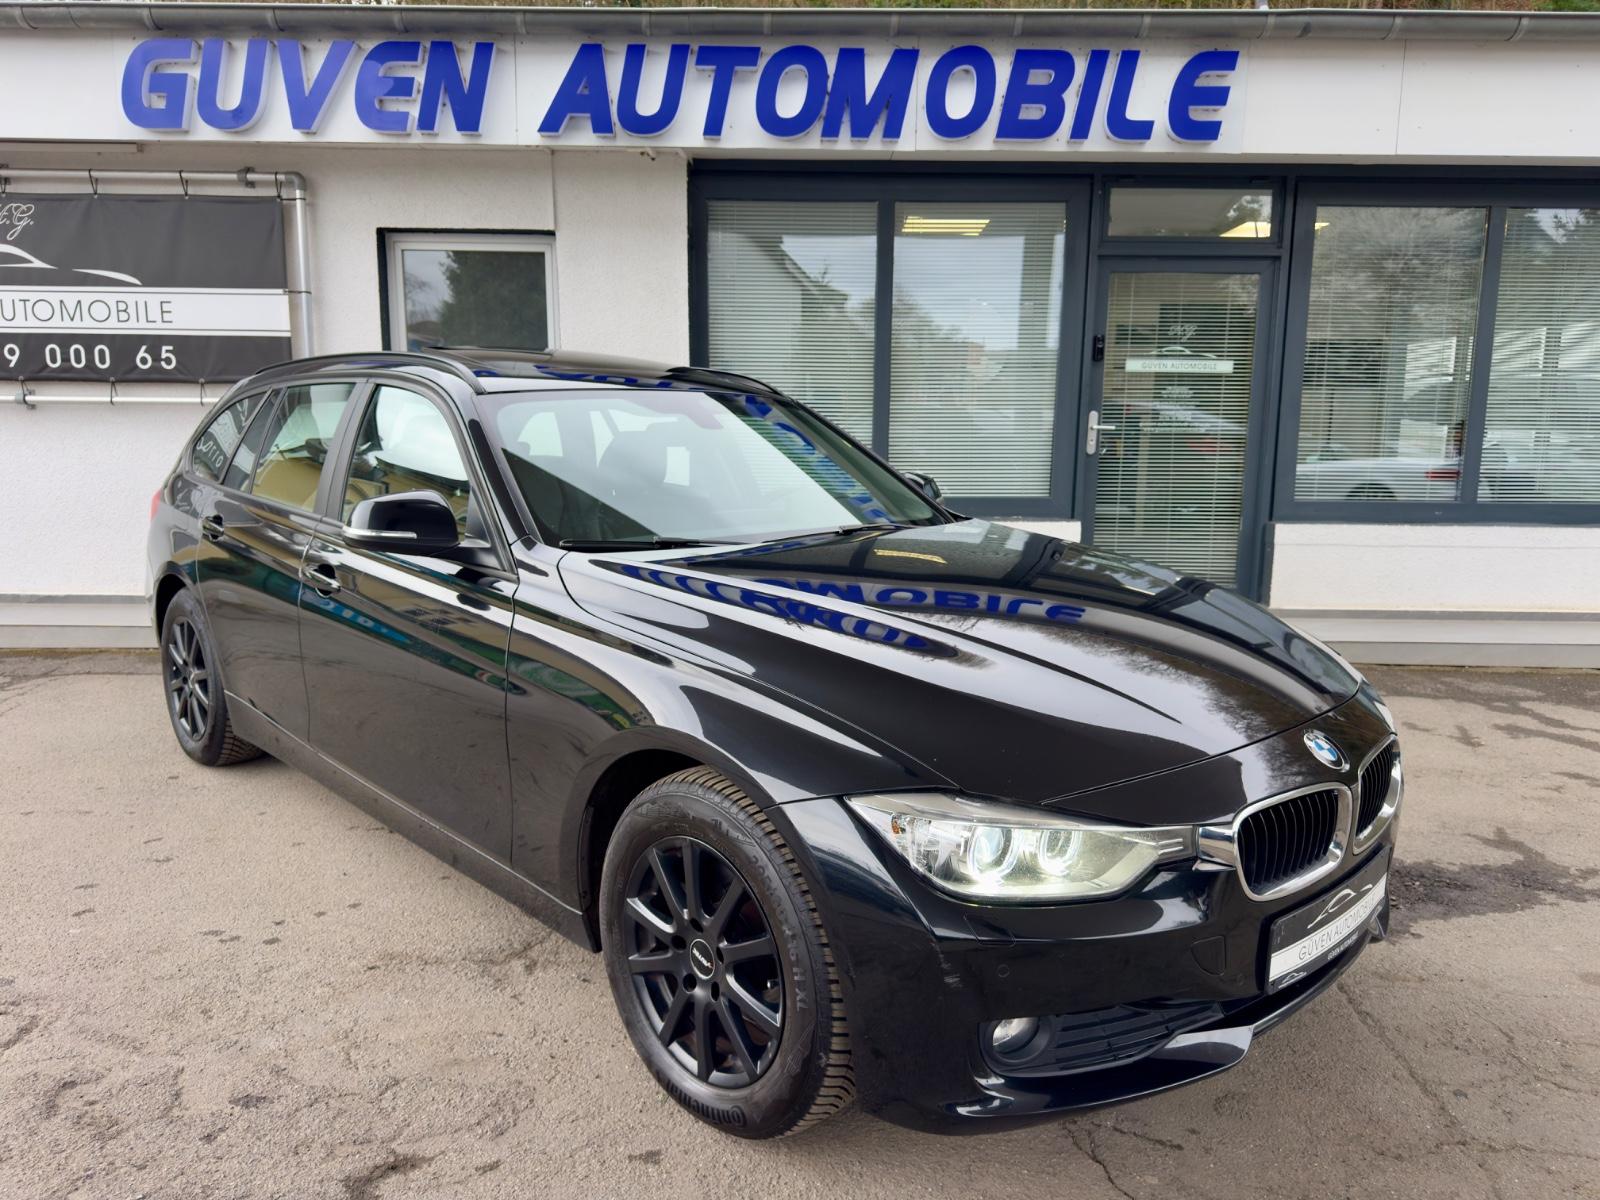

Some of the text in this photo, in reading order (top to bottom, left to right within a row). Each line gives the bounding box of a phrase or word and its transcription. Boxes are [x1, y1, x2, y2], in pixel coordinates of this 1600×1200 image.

[121, 37, 1240, 144] GUVEN AUTOMOBILE
[0, 298, 173, 324] UTOMOBILE
[3, 343, 177, 370] 9 000 65
